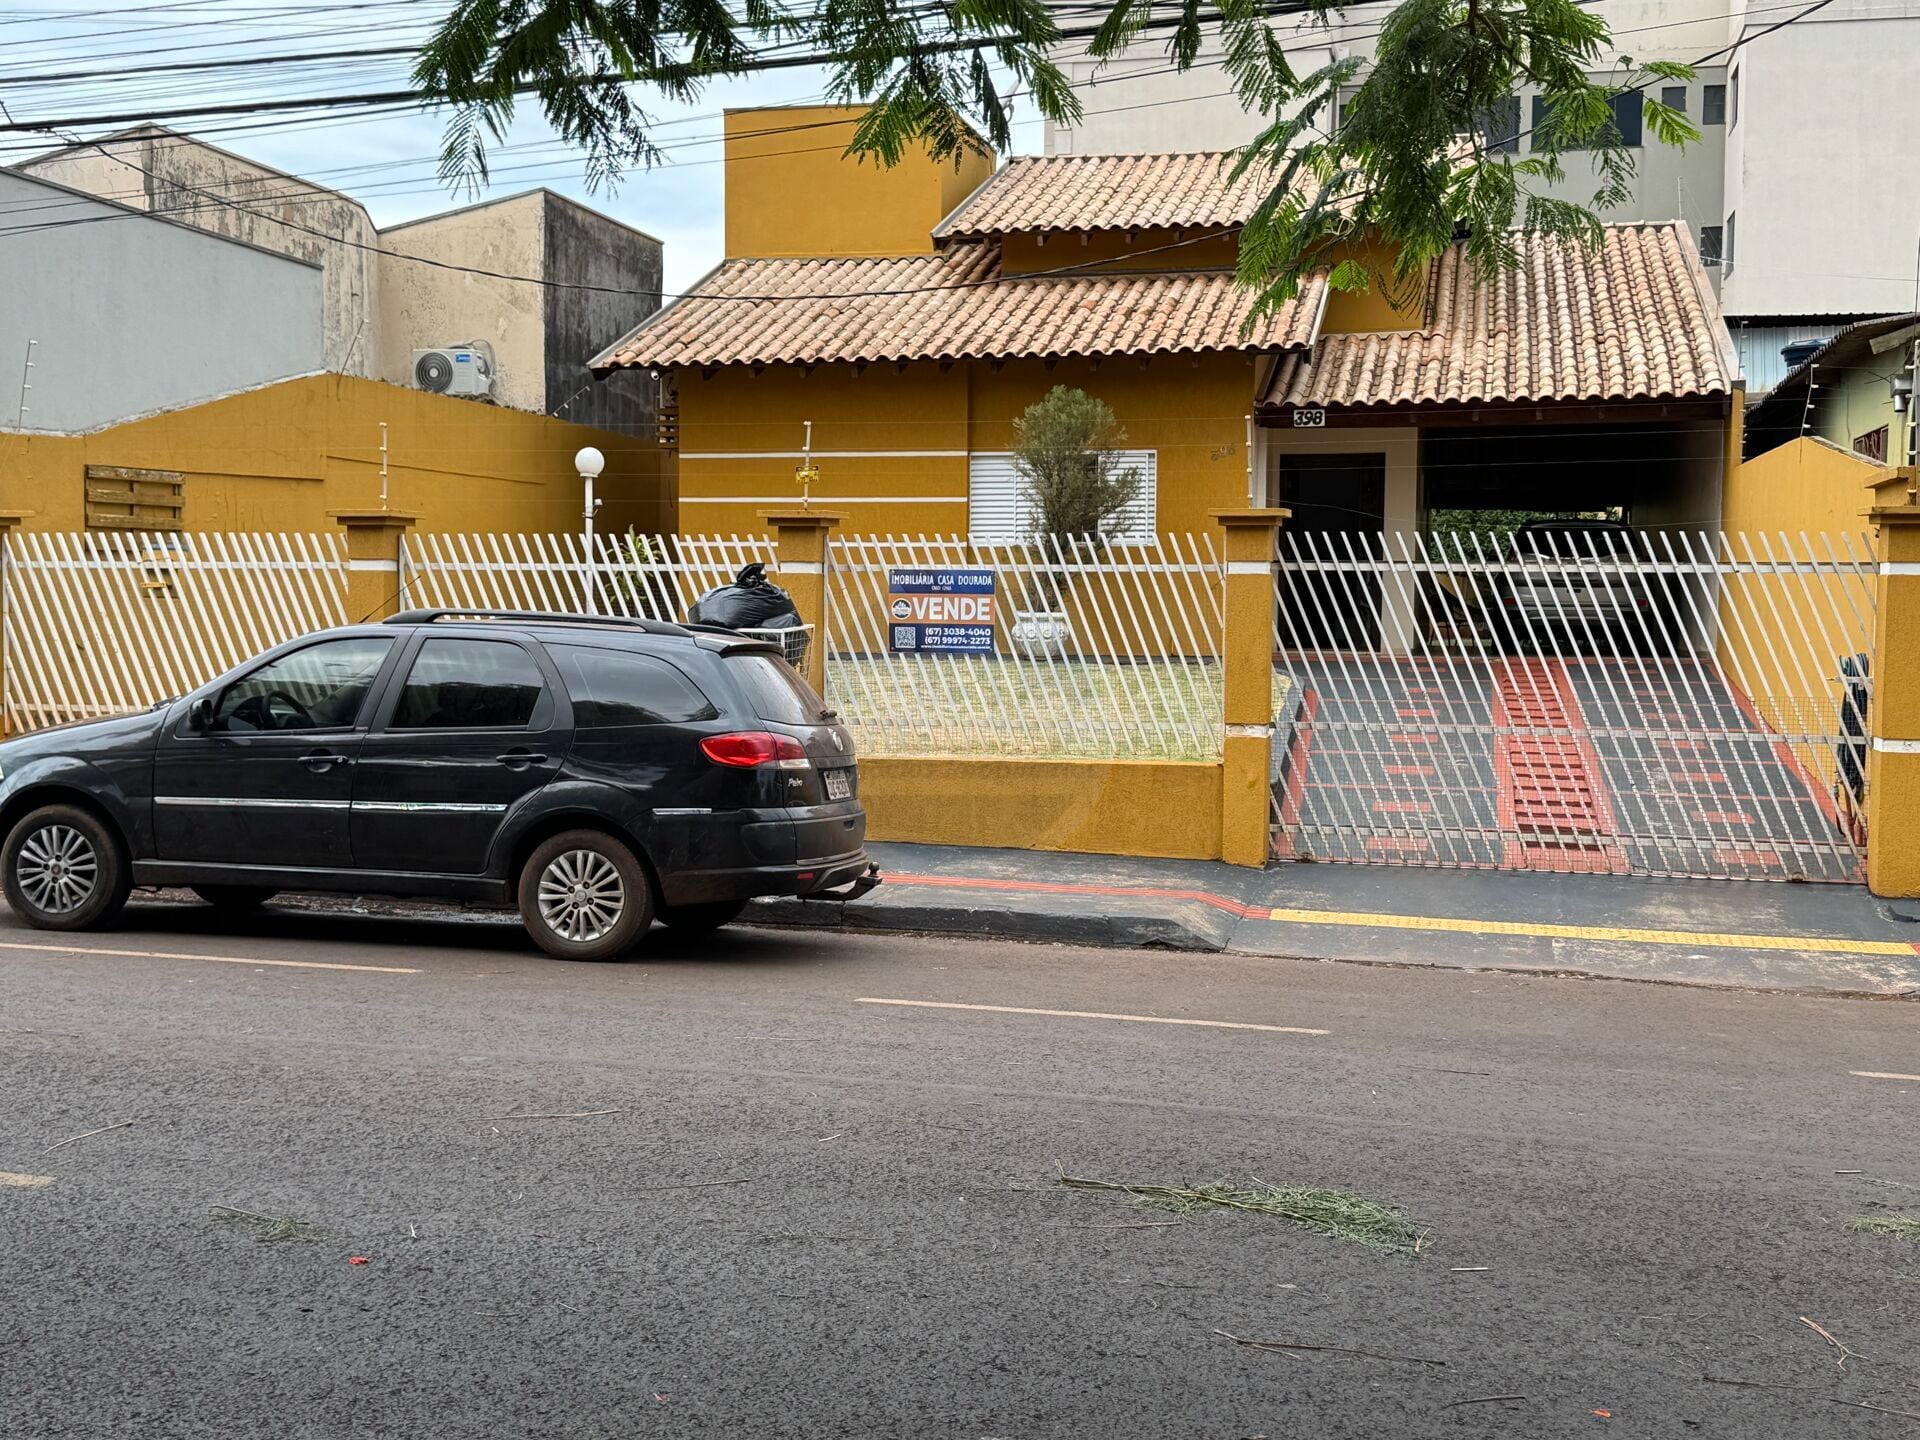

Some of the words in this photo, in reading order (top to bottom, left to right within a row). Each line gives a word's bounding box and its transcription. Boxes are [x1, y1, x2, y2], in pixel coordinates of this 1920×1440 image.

[1294, 410, 1323, 426] 398
[892, 573, 934, 585] IMOBILIÁRIA
[938, 576, 954, 585] CASA
[958, 576, 992, 585] DOURADA
[912, 597, 990, 621] VENDE
[925, 627, 942, 636] (67)
[943, 628, 991, 636] 3038-4040
[925, 636, 941, 645] (67)
[942, 637, 991, 645] 99974-2273
